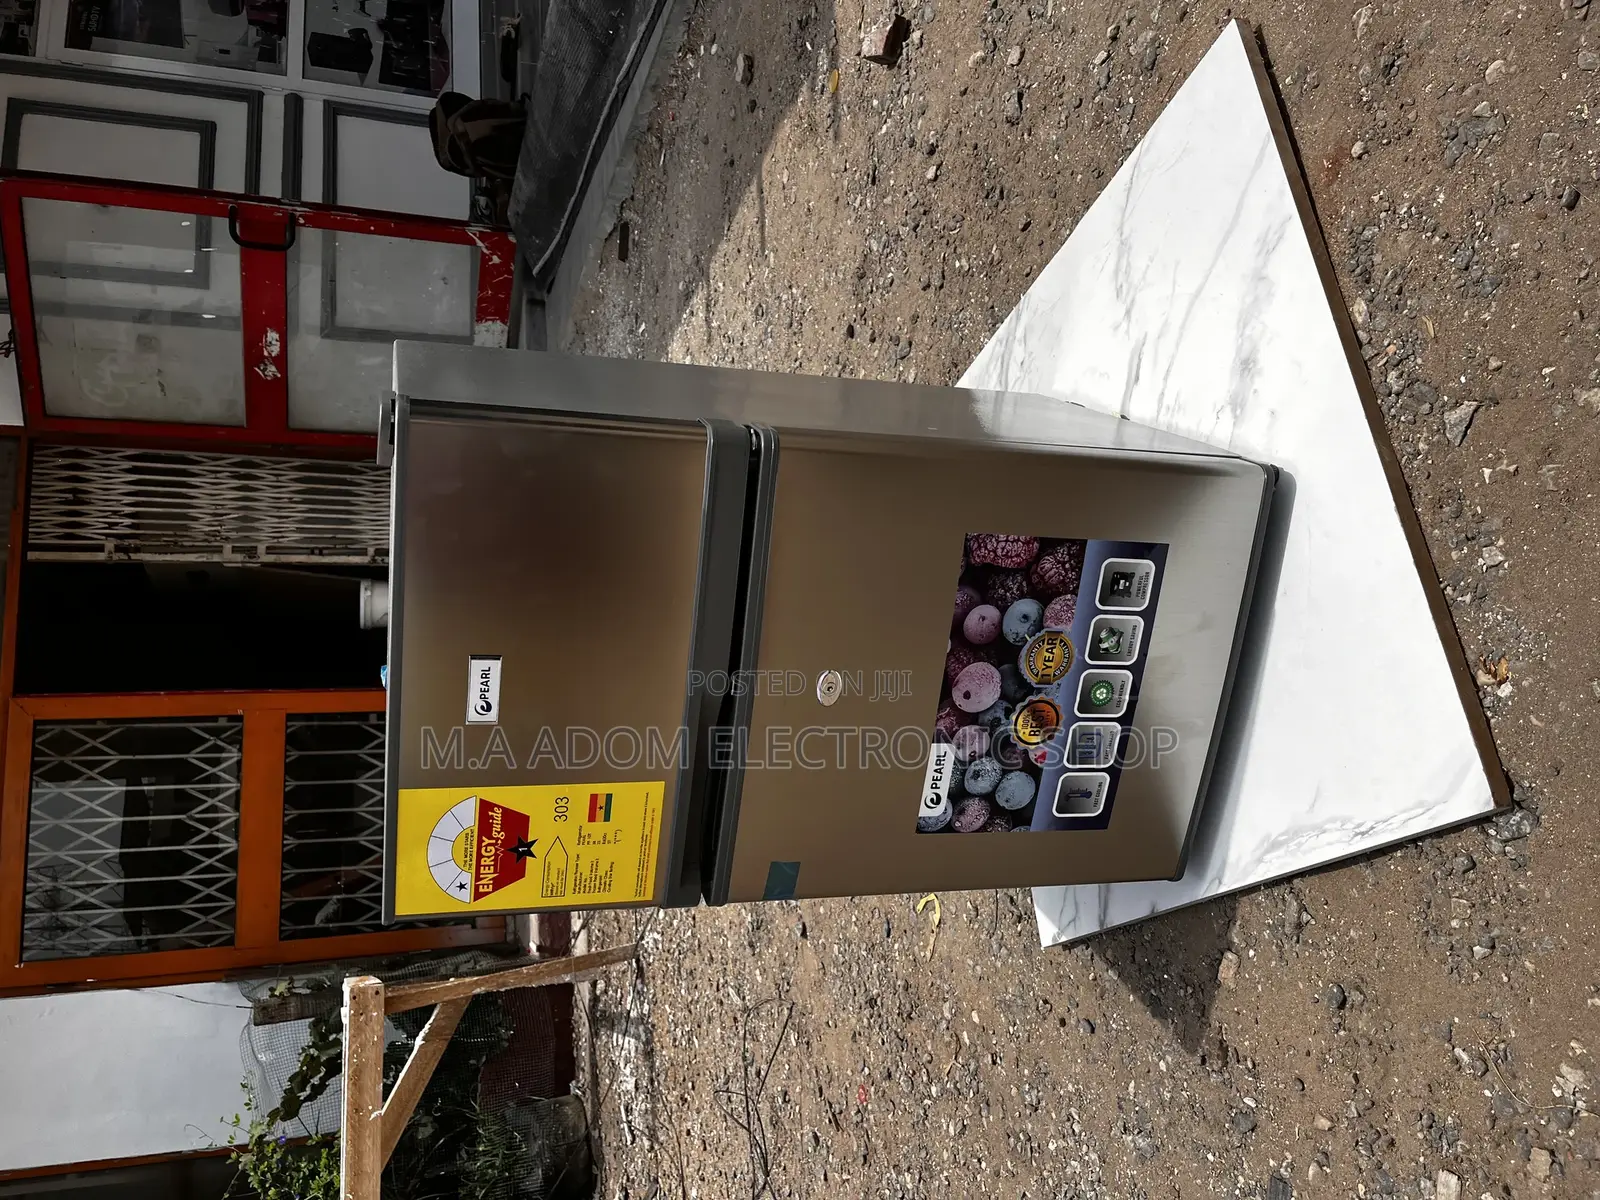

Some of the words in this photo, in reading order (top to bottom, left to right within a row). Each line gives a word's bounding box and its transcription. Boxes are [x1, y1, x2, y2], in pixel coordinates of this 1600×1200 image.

[1135, 575, 1144, 598] POWERFUL
[1140, 571, 1150, 600] COMPRESSOR
[1129, 625, 1138, 640] SAVING
[1029, 637, 1045, 676] WARRANTY
[1041, 637, 1058, 673] YEAR
[1053, 641, 1070, 676] WARRANTY
[1126, 640, 1135, 657] ENERGY
[479, 666, 491, 700] PEARL
[1021, 714, 1031, 730] 100%
[1029, 708, 1046, 736] BEST
[930, 750, 947, 790] PEARL
[553, 796, 570, 823] 303
[475, 836, 500, 893] ENERGY
[488, 806, 506, 839] guide
